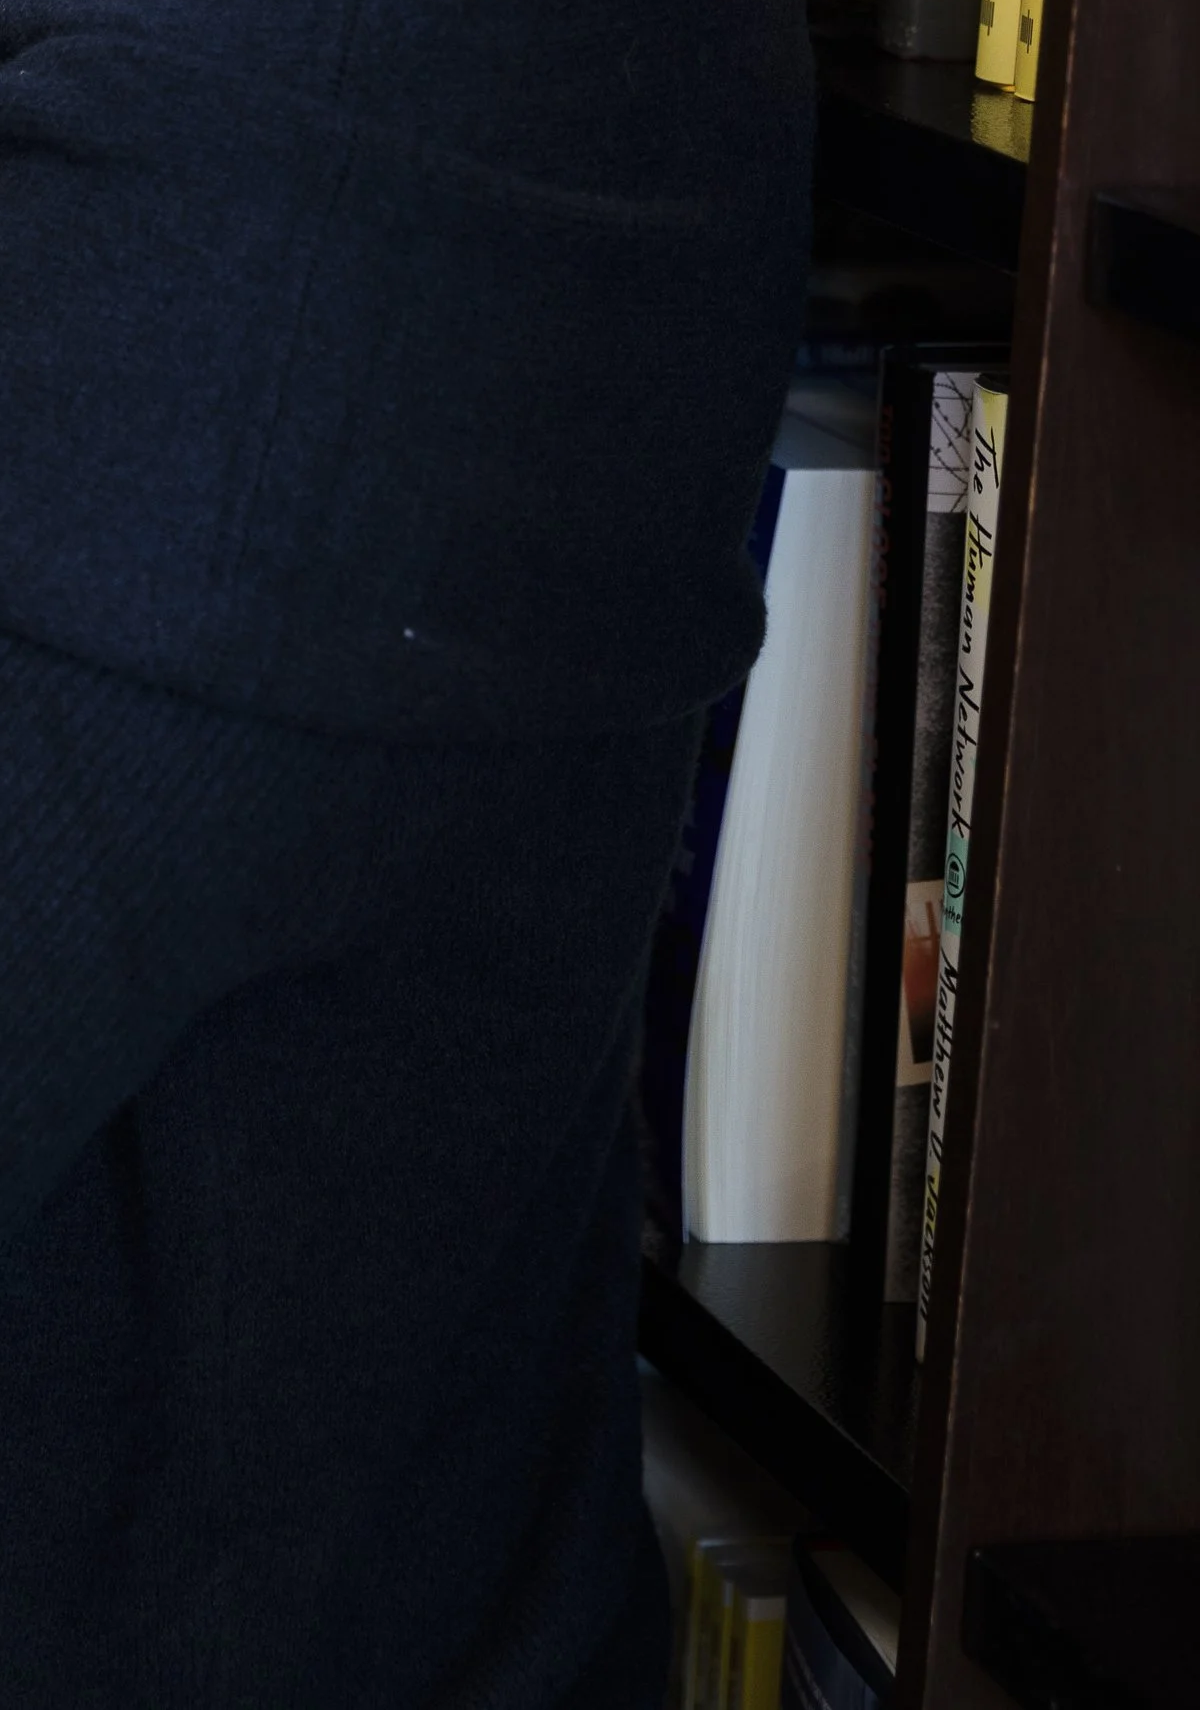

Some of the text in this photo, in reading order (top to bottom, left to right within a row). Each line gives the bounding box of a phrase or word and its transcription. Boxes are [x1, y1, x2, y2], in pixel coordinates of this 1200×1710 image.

[951, 426, 999, 839] The Human Network
[932, 945, 958, 1119] Matthew
[920, 1174, 938, 1322] Jackson
